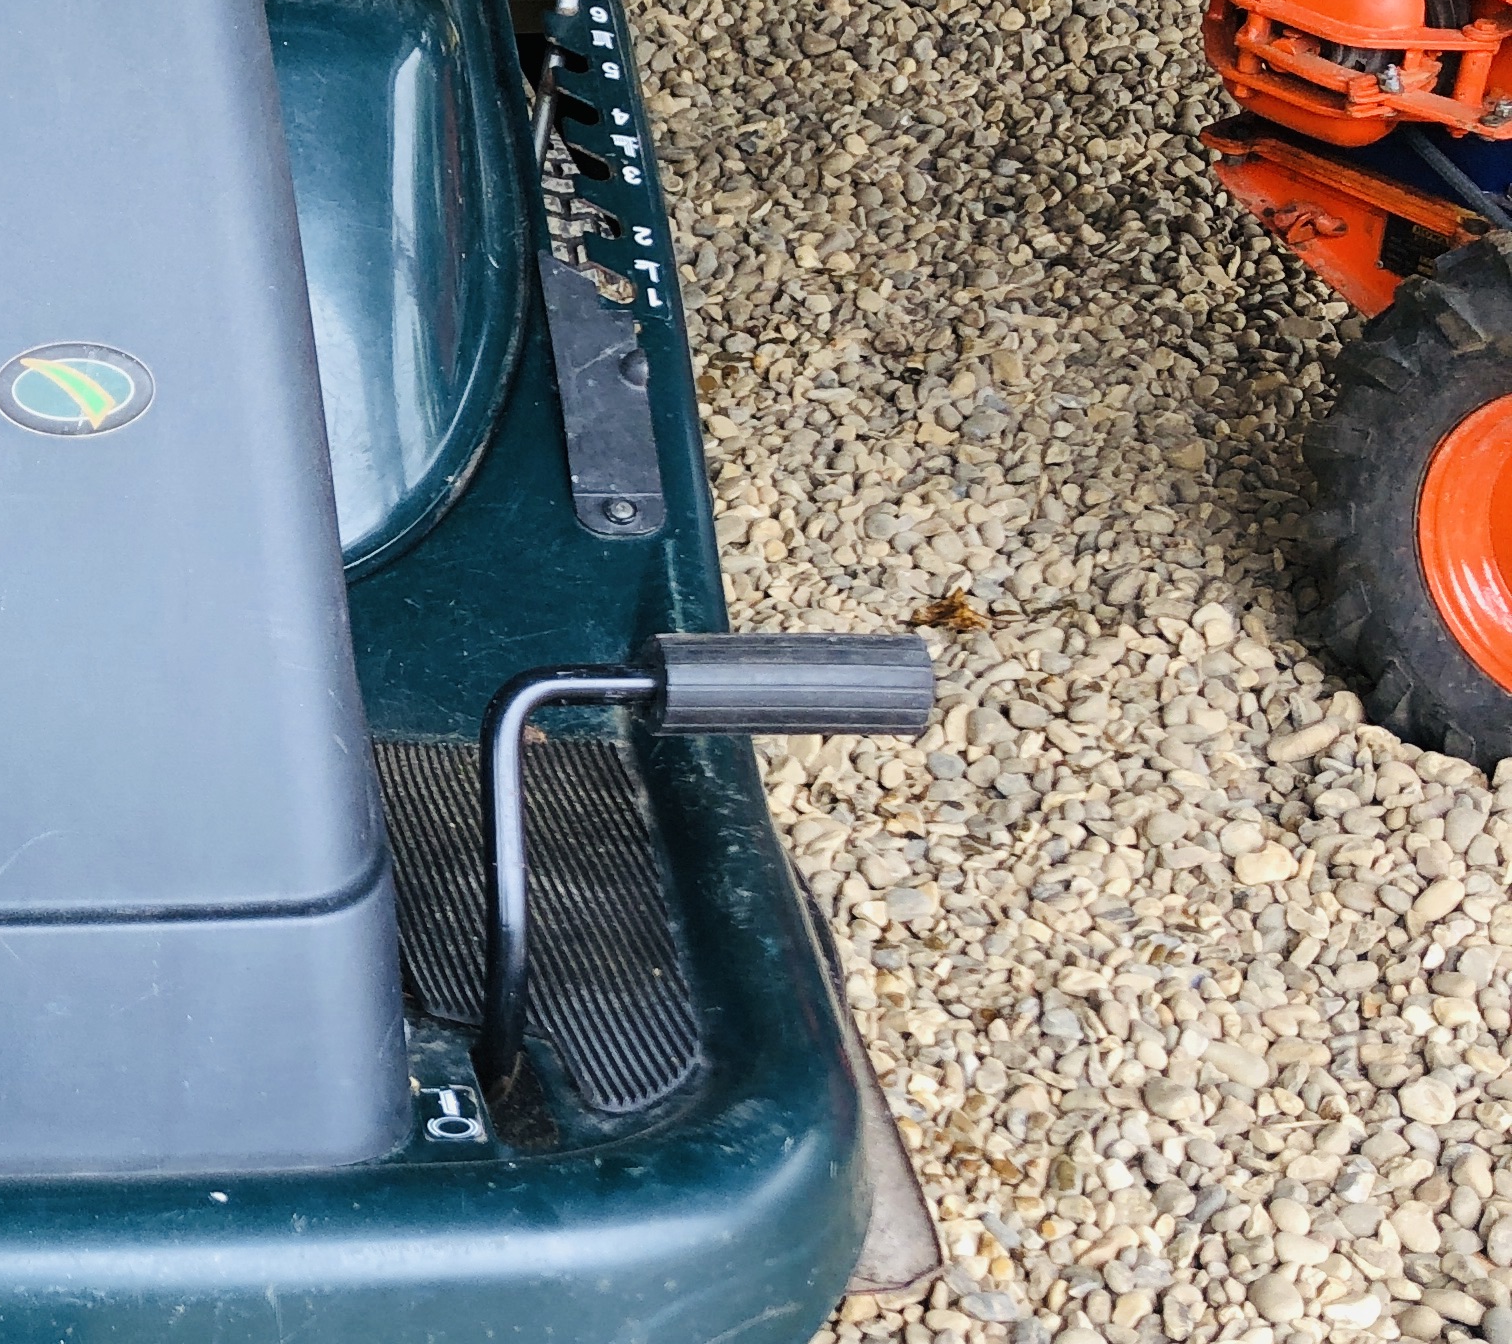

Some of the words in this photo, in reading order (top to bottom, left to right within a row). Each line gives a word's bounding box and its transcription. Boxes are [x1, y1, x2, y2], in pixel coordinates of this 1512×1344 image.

[601, 61, 621, 81] 5
[611, 107, 631, 126] 4
[621, 165, 643, 186] 3
[632, 225, 654, 247] 2
[646, 287, 664, 308] 1
